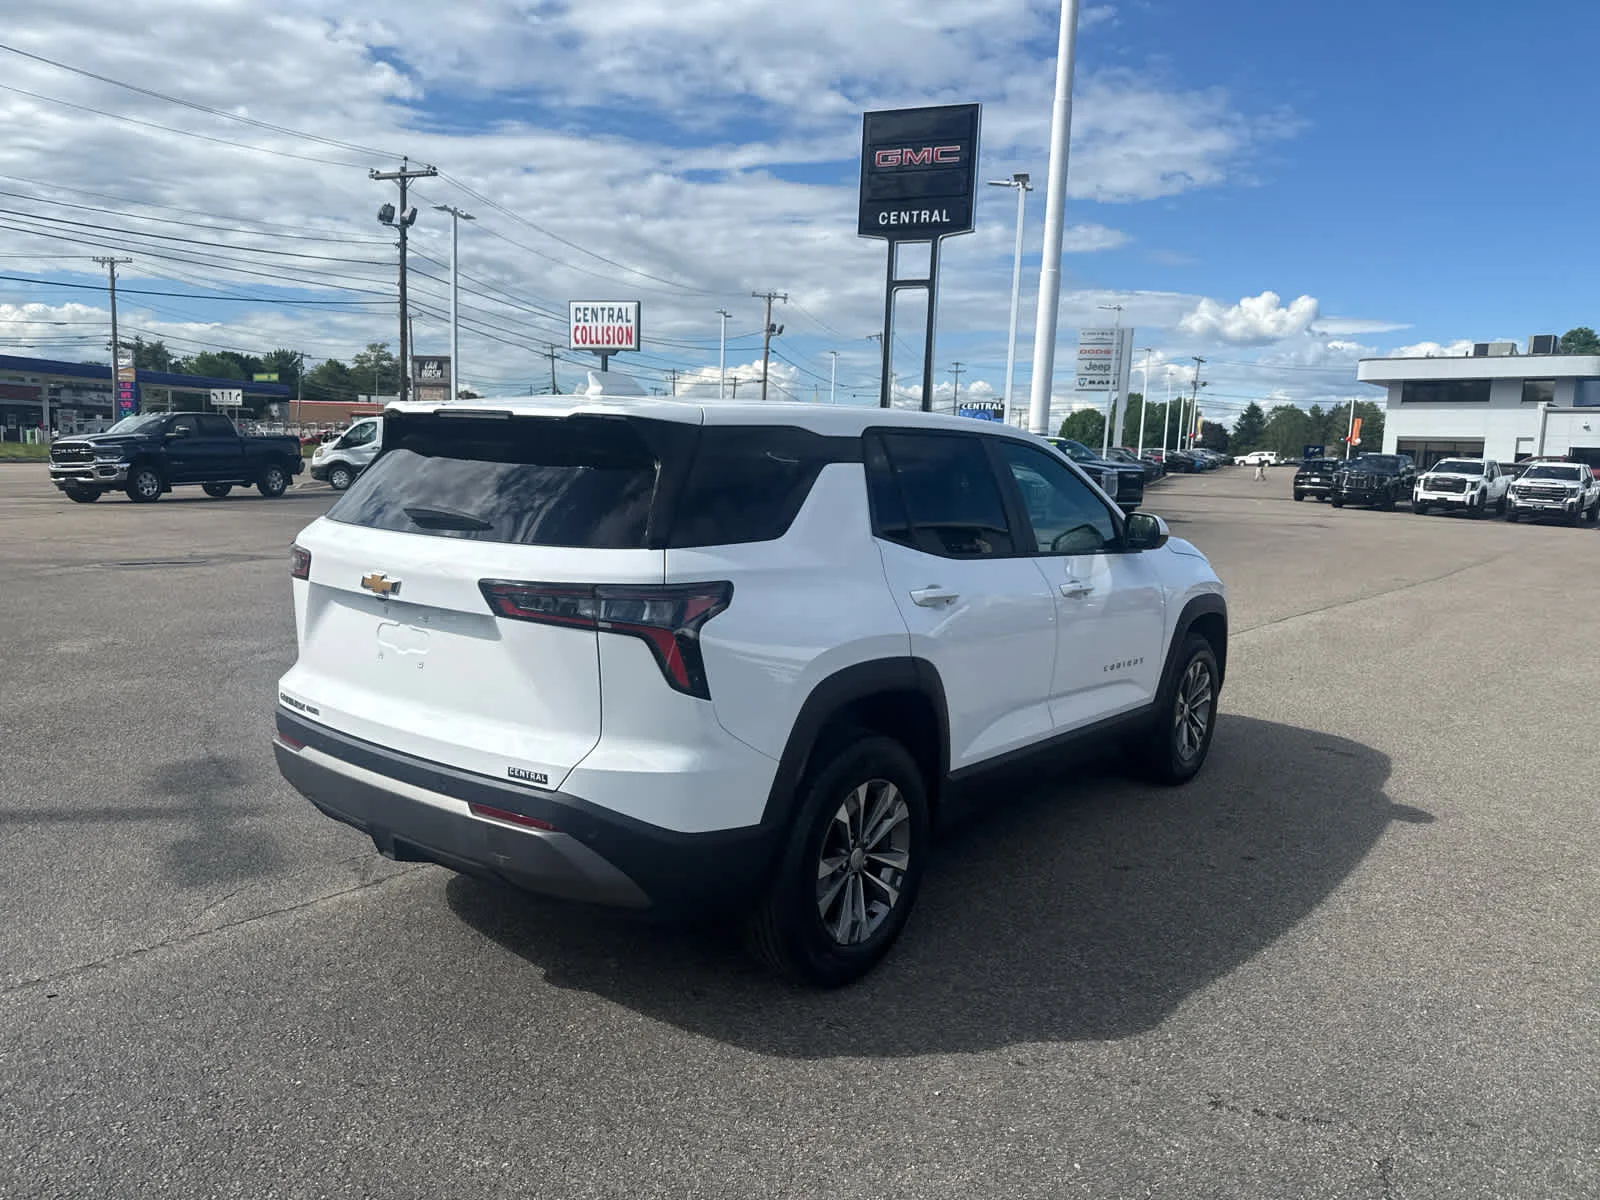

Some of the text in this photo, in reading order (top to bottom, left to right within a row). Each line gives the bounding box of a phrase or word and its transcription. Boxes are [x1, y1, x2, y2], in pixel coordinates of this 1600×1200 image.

[875, 145, 961, 168] GMC
[878, 209, 951, 225] CENTRAL
[575, 307, 632, 323] CENTRAL
[573, 325, 633, 345] COLLISION
[1084, 362, 1111, 372] Jeep
[961, 402, 1004, 410] CENTRAL
[509, 767, 547, 783] CENTRAL
